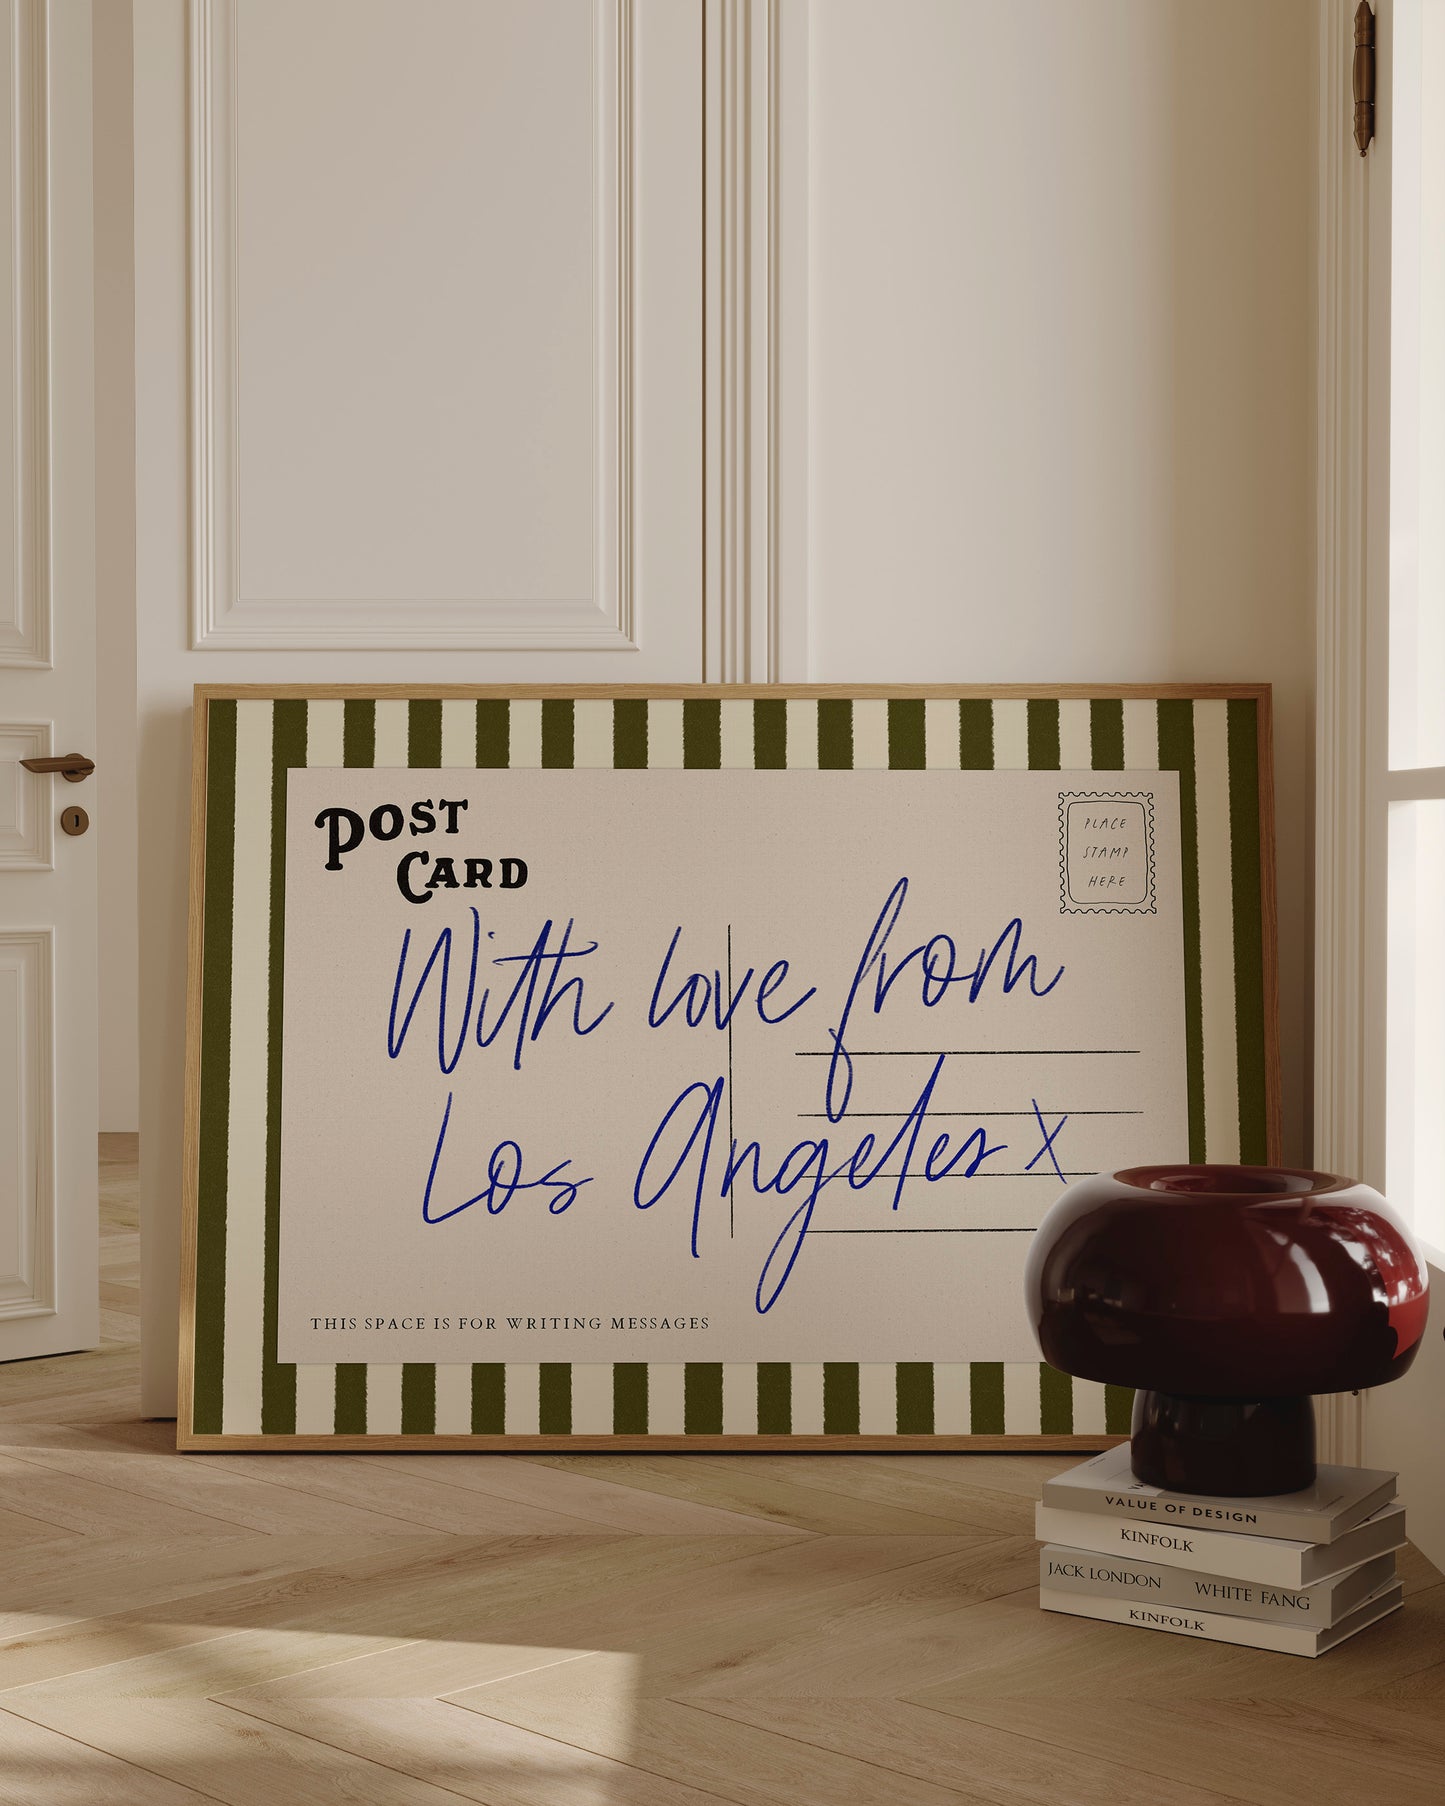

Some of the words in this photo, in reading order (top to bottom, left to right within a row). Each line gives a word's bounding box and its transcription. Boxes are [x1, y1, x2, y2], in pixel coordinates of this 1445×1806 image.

[314, 799, 469, 871] POST
[1084, 817, 1127, 830] PLACE
[1082, 846, 1129, 859] STAMP
[396, 851, 529, 904] CARD
[1088, 875, 1126, 888] HERE
[387, 906, 615, 1074] With
[647, 926, 817, 1031] love
[826, 876, 1065, 1123] from
[422, 1091, 594, 1225] Los
[633, 1052, 1008, 1314] Angeles
[310, 1317, 357, 1330] THIS
[364, 1317, 425, 1330] SPACE
[433, 1317, 450, 1330] IS
[458, 1317, 497, 1330] FOR
[505, 1317, 601, 1330] WRITING
[610, 1317, 709, 1330] MESSAGES
[1105, 1495, 1157, 1511] VALUE
[1164, 1503, 1186, 1514] OF
[1192, 1507, 1258, 1524] DESIGN
[1120, 1528, 1194, 1553] KINFOLK
[1048, 1562, 1086, 1579] JACK
[1090, 1567, 1162, 1589] LONDON
[1194, 1581, 1253, 1603] WHITE
[1261, 1591, 1311, 1611] FANG
[1128, 1609, 1206, 1632] KINFOLK
